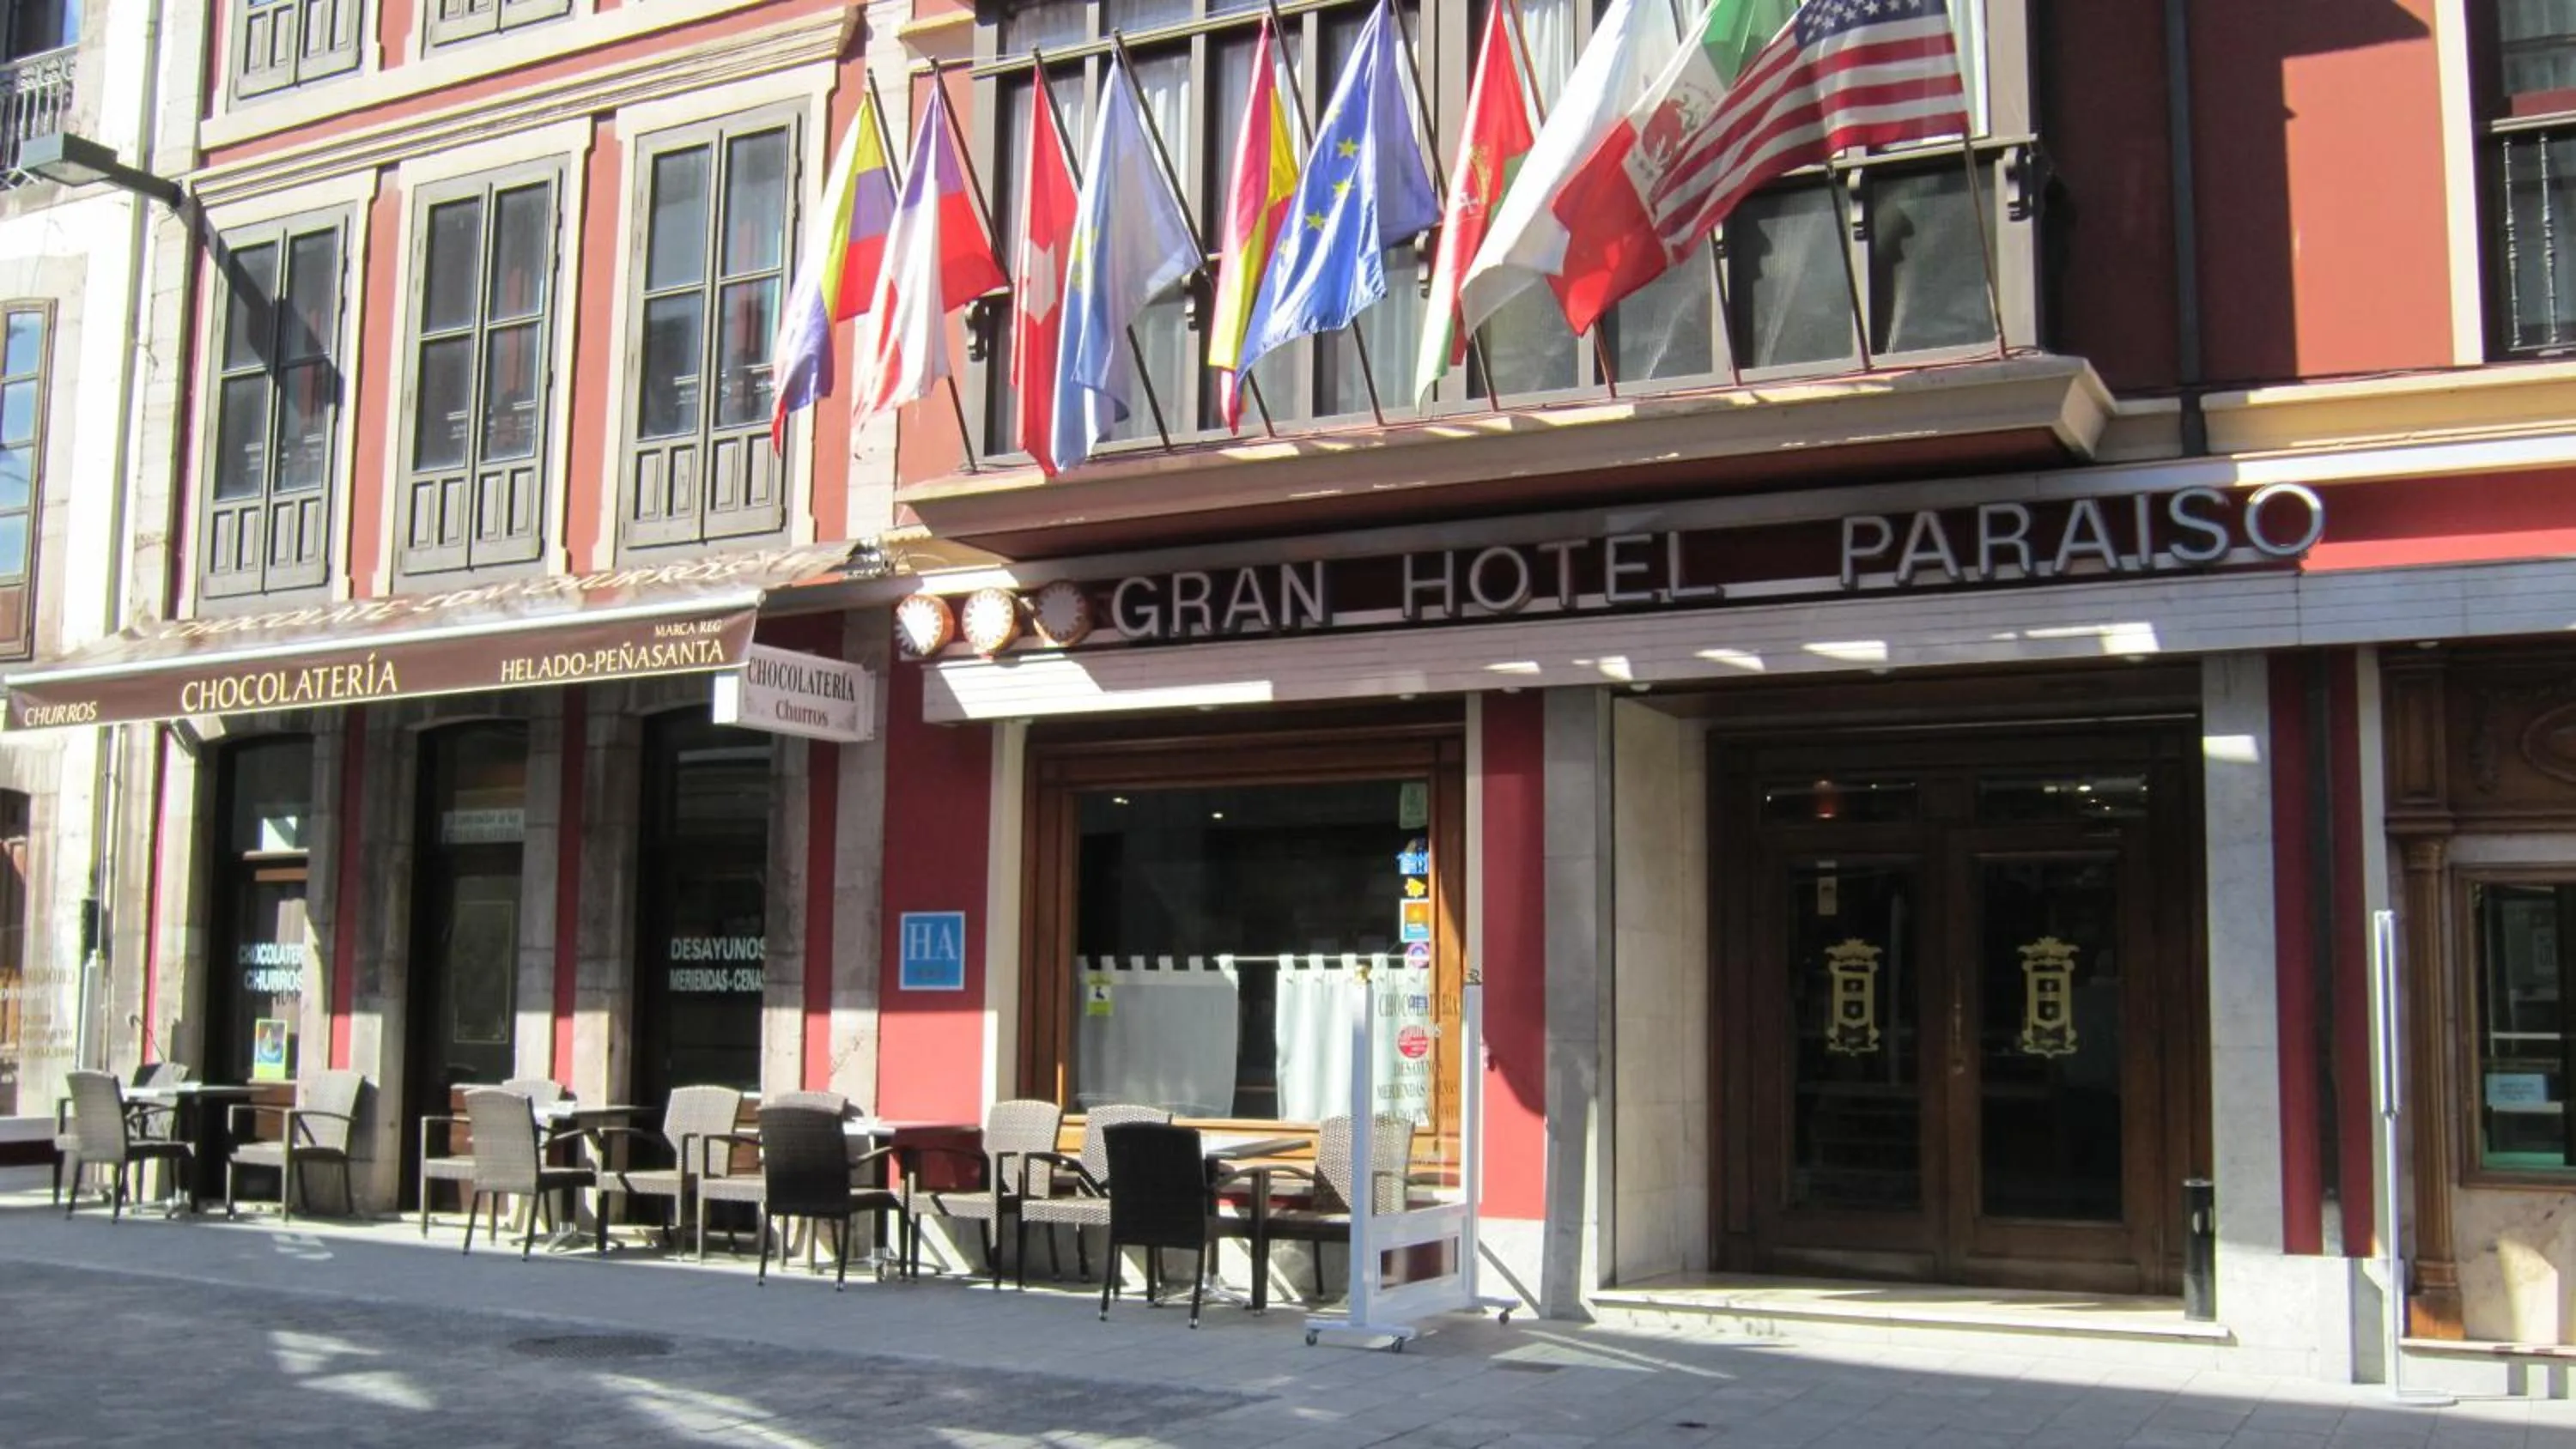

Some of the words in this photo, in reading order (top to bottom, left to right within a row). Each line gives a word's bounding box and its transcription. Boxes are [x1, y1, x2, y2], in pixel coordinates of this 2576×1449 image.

[1111, 560, 1331, 642] GRAN
[1403, 530, 1724, 621] HOTEL
[1839, 482, 2325, 591] PARAISO
[654, 622, 696, 637] MARCA
[501, 639, 725, 683] HELADO-PEÑASANTA
[181, 651, 398, 713] CHOCOLATERÍA
[747, 656, 855, 702] CHOCOLATERÍA
[24, 700, 98, 728] CHURROS
[775, 699, 830, 727] Churros
[671, 937, 767, 961] DESAYUNOS
[906, 920, 959, 961] HA
[245, 969, 303, 991] CHURROS
